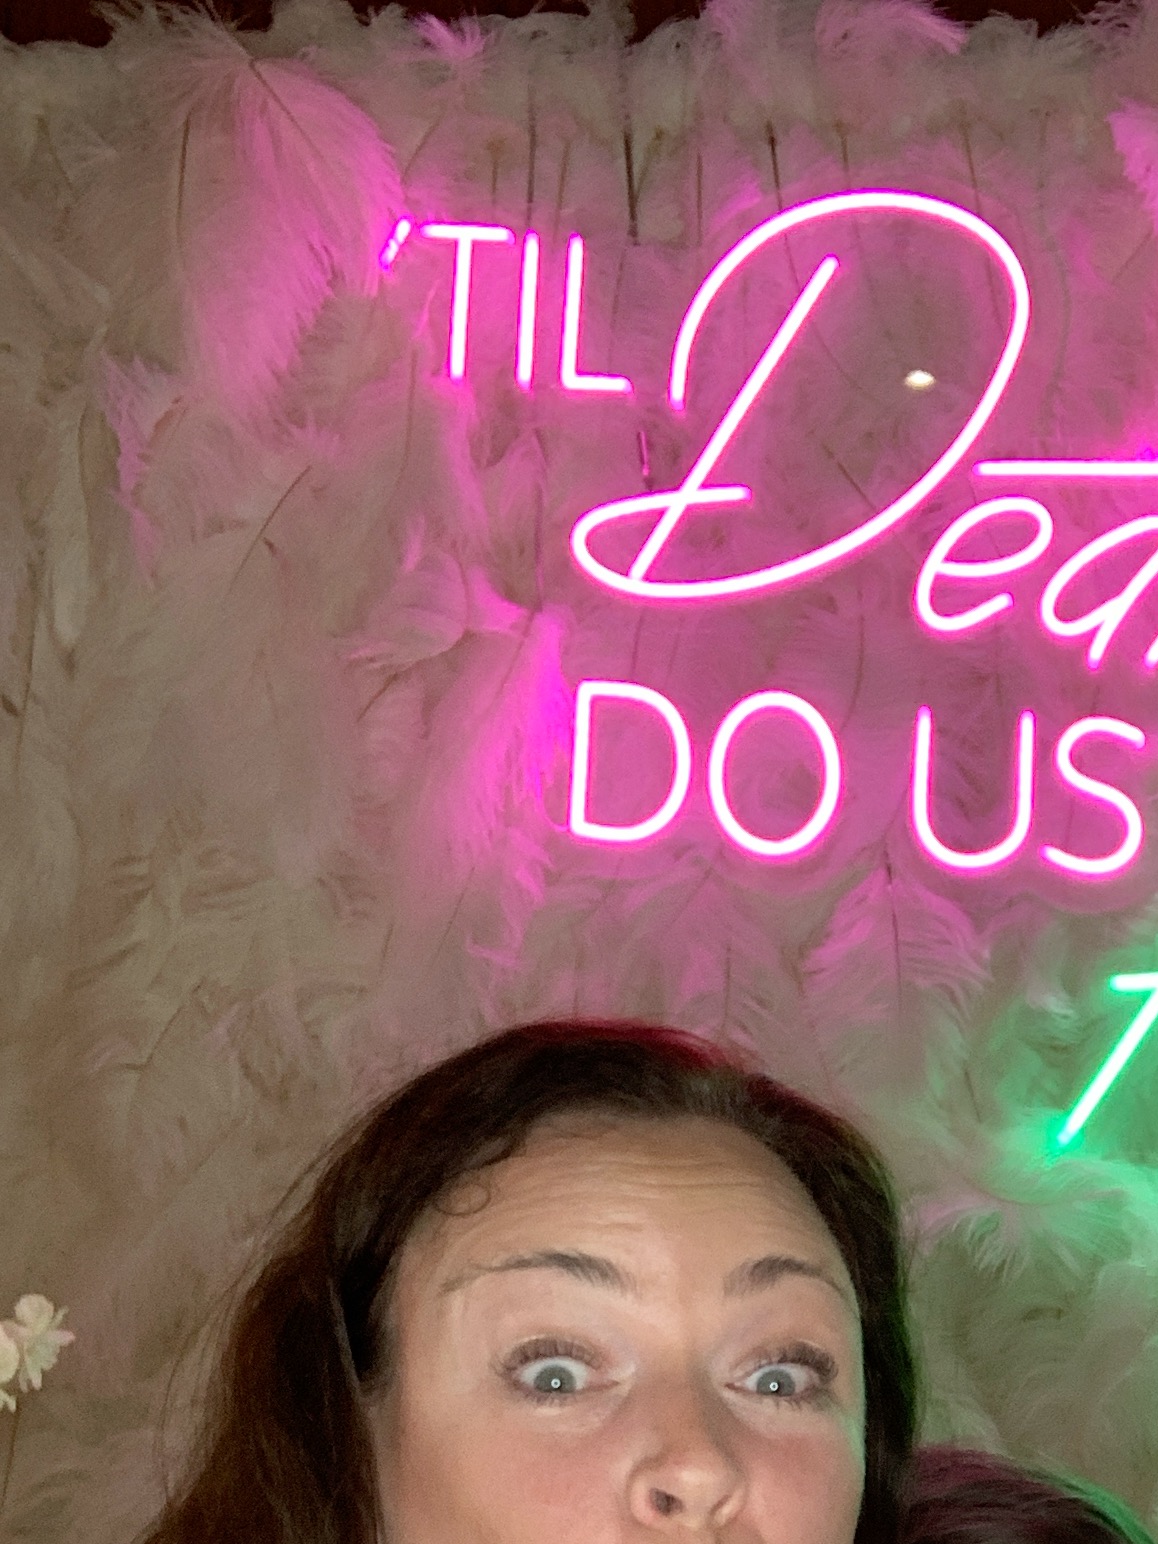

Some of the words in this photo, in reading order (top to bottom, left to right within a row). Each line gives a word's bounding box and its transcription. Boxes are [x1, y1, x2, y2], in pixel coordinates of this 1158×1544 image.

[379, 216, 634, 393] 'TIL
[566, 679, 844, 860] DO
[911, 705, 1148, 877] US
